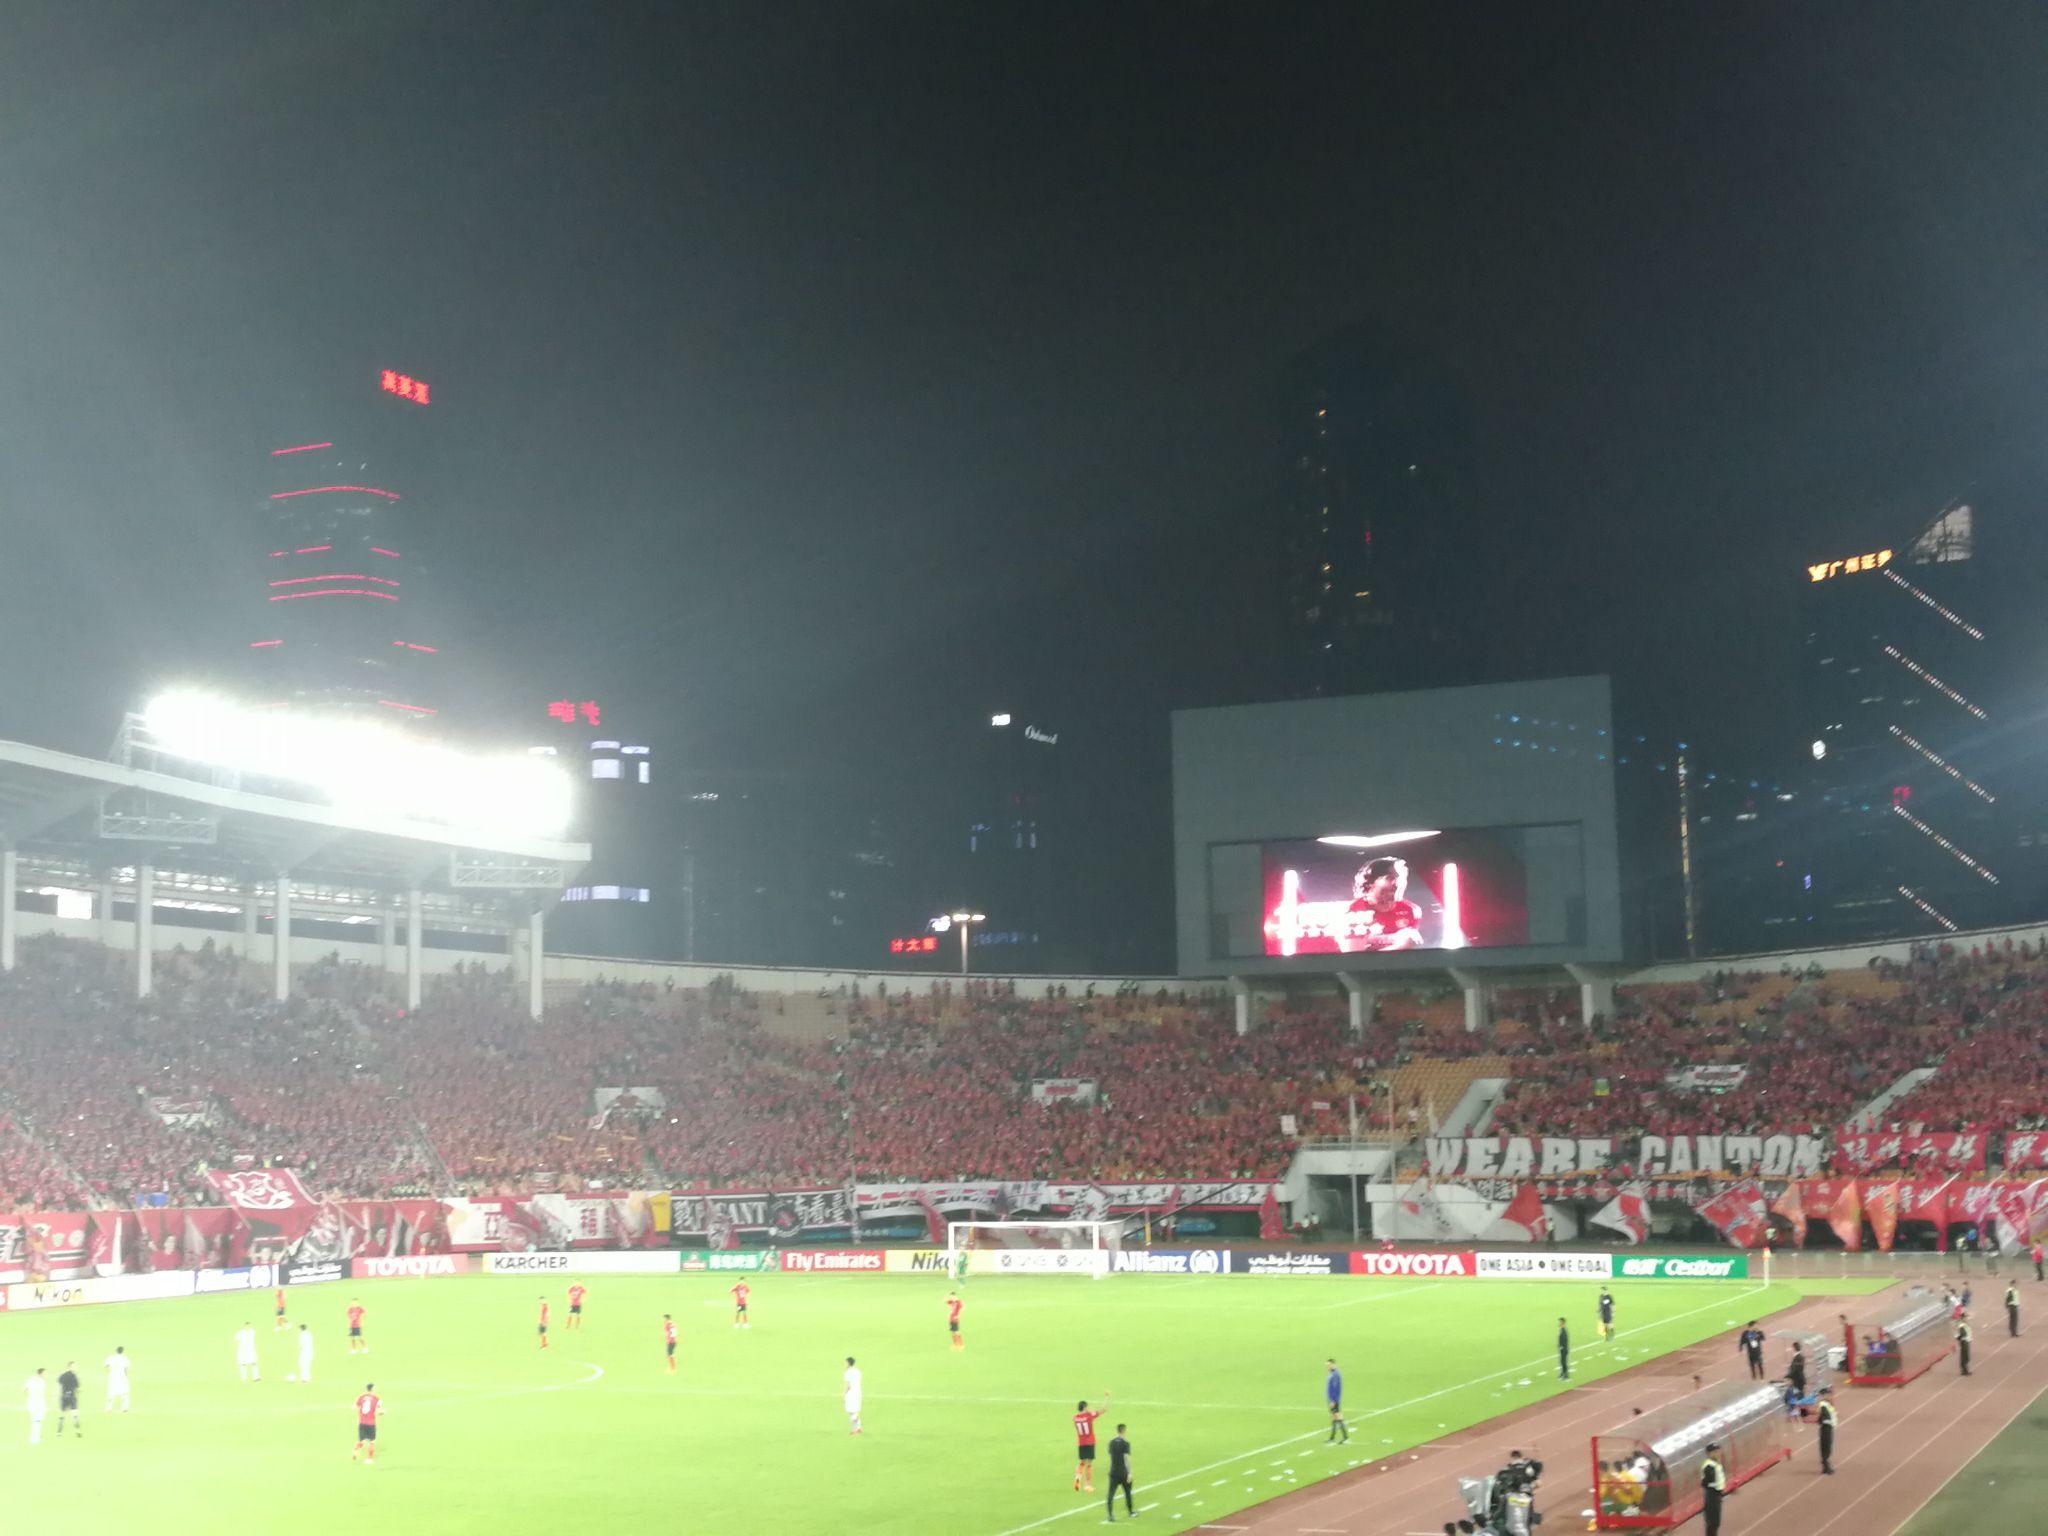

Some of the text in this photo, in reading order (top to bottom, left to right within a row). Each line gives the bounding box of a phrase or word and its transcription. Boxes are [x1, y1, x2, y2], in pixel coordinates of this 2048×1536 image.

[1639, 1135, 1822, 1176] CANTON
[364, 1255, 456, 1275] TOYOTA
[787, 1253, 880, 1270] Fly Emirates
[1114, 1251, 1187, 1272] Allianz
[1363, 1253, 1465, 1274] TOYOTA
[1577, 1259, 1609, 1272] GOAL
[1076, 1421, 1089, 1435] 11
